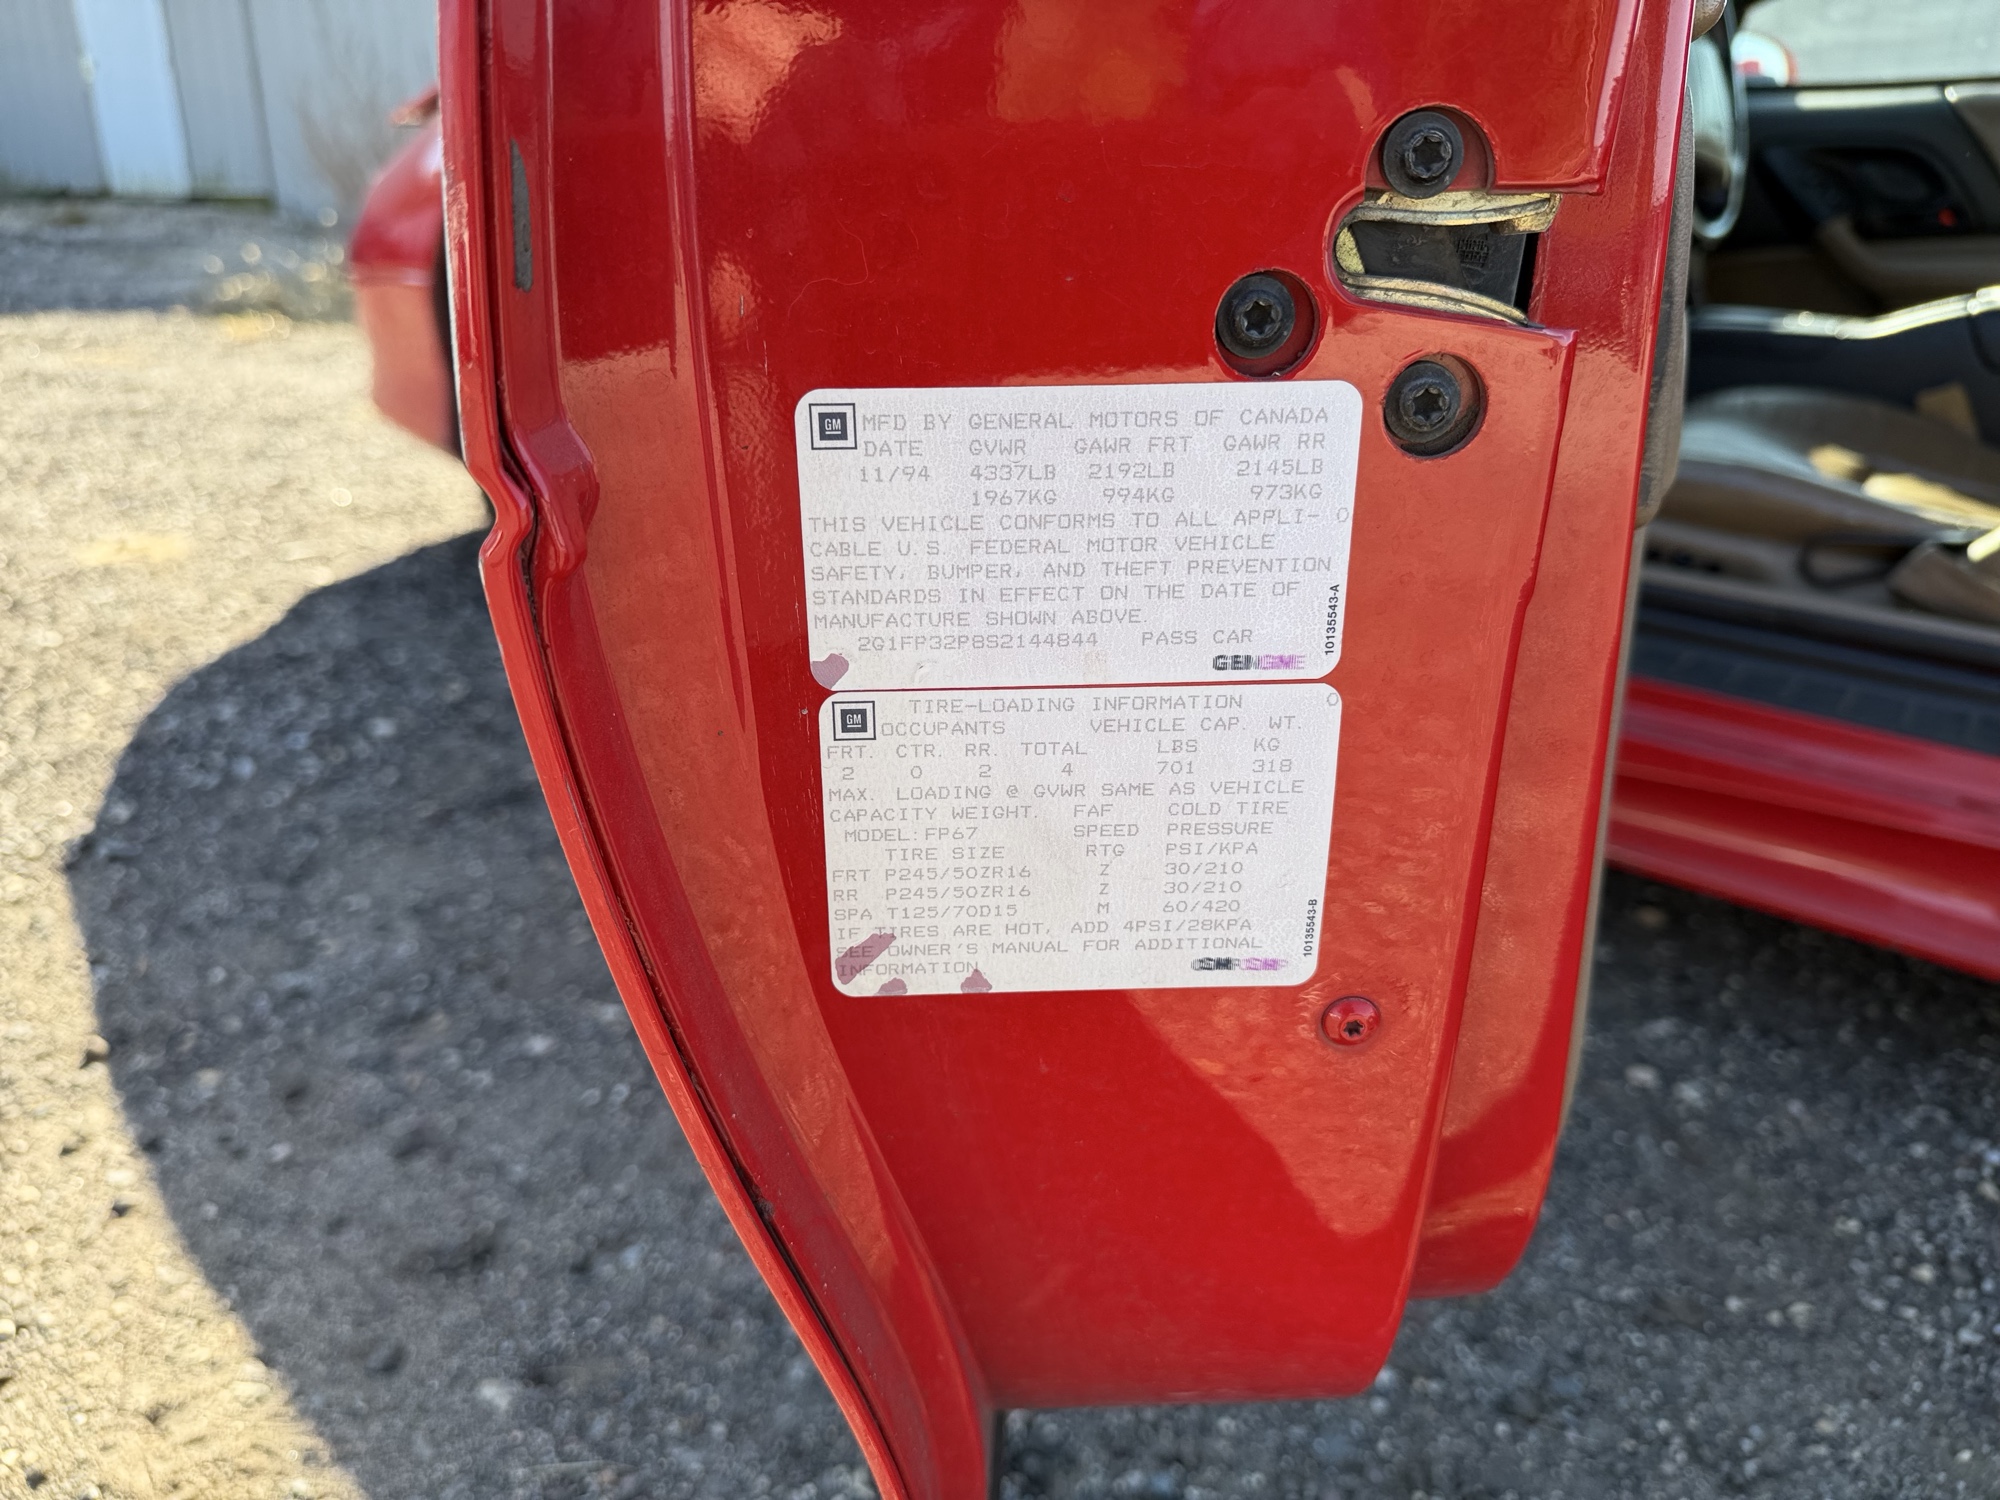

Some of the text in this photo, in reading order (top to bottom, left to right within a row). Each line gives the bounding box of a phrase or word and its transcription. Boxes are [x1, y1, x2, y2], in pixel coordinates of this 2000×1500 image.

[825, 418, 842, 434] GM
[862, 407, 1328, 431] MFD BY GENERAL MOTORS OF CANADA
[863, 433, 1325, 457] DATE GVWR GAWR FRT GAWR RR
[860, 459, 1323, 482] 11/94 4337LB 2192LB 2145LB
[972, 484, 1322, 506] 1967KG 994KG 973KG
[808, 516, 866, 533] THIS
[881, 514, 984, 532] VEHICLE
[1000, 512, 1115, 531] CONFORMS
[1132, 512, 1159, 528] TO
[1175, 511, 1217, 528] ALL
[1233, 509, 1320, 526] APPLI-
[810, 541, 882, 558] CABLE
[970, 538, 1070, 555] FEDERAL
[1087, 537, 1157, 553] MOTOR
[1174, 534, 1275, 551] VEHICLE
[811, 556, 1332, 581] SAFETY, BUMPER, AND THEFT PREVENTION
[812, 581, 1301, 605] STANDARDS IN EFFECT ON THE DATE OF
[814, 608, 1148, 629] MANUFACTURE SHOWN ABOVE.
[1324, 584, 1340, 656] 10135543-A
[1141, 631, 1198, 646] PASS
[1213, 629, 1253, 644] CAR
[909, 697, 1075, 714] TIRE-LOADING
[1092, 695, 1243, 712] INFORMATION
[846, 714, 862, 728] GM
[881, 715, 1302, 736] OCCUPANTS VEHICLE CAP. WT.
[827, 737, 1281, 760] FRT. CTR. RR. TOTAL LBS KG
[842, 766, 854, 781] 2
[978, 764, 992, 778] 2
[1061, 762, 1074, 777] 4
[1157, 760, 1194, 775] 701
[1252, 758, 1293, 773] 318
[828, 779, 1305, 802] MAX. LOADING @ GVWR SAME AS VEHICLE
[829, 807, 938, 823] CAPACITY
[951, 805, 1038, 820] WEIGHT.
[1168, 801, 1221, 816] COLD
[1236, 800, 1289, 816] TIRE
[1073, 823, 1139, 838] SPEED
[1166, 821, 1274, 836] PRESSURE
[885, 841, 1258, 861] TIRE SIZE RTG PSI/KPA
[832, 861, 1243, 883] FRT P245/50ZR16 Z 30/210
[833, 880, 1243, 902] RR P245/50ZR16 Z 30/210
[834, 899, 1240, 921] SPA T125/70D15 M 60/420
[837, 917, 1252, 941] IF TIRES ARE HOT, ADD 4PSI/28KPA
[1303, 898, 1318, 957] 10135543-B
[992, 940, 1068, 954] MANUAL
[1083, 938, 1119, 951] FOR
[1135, 936, 1262, 950] ADDITIONAL
